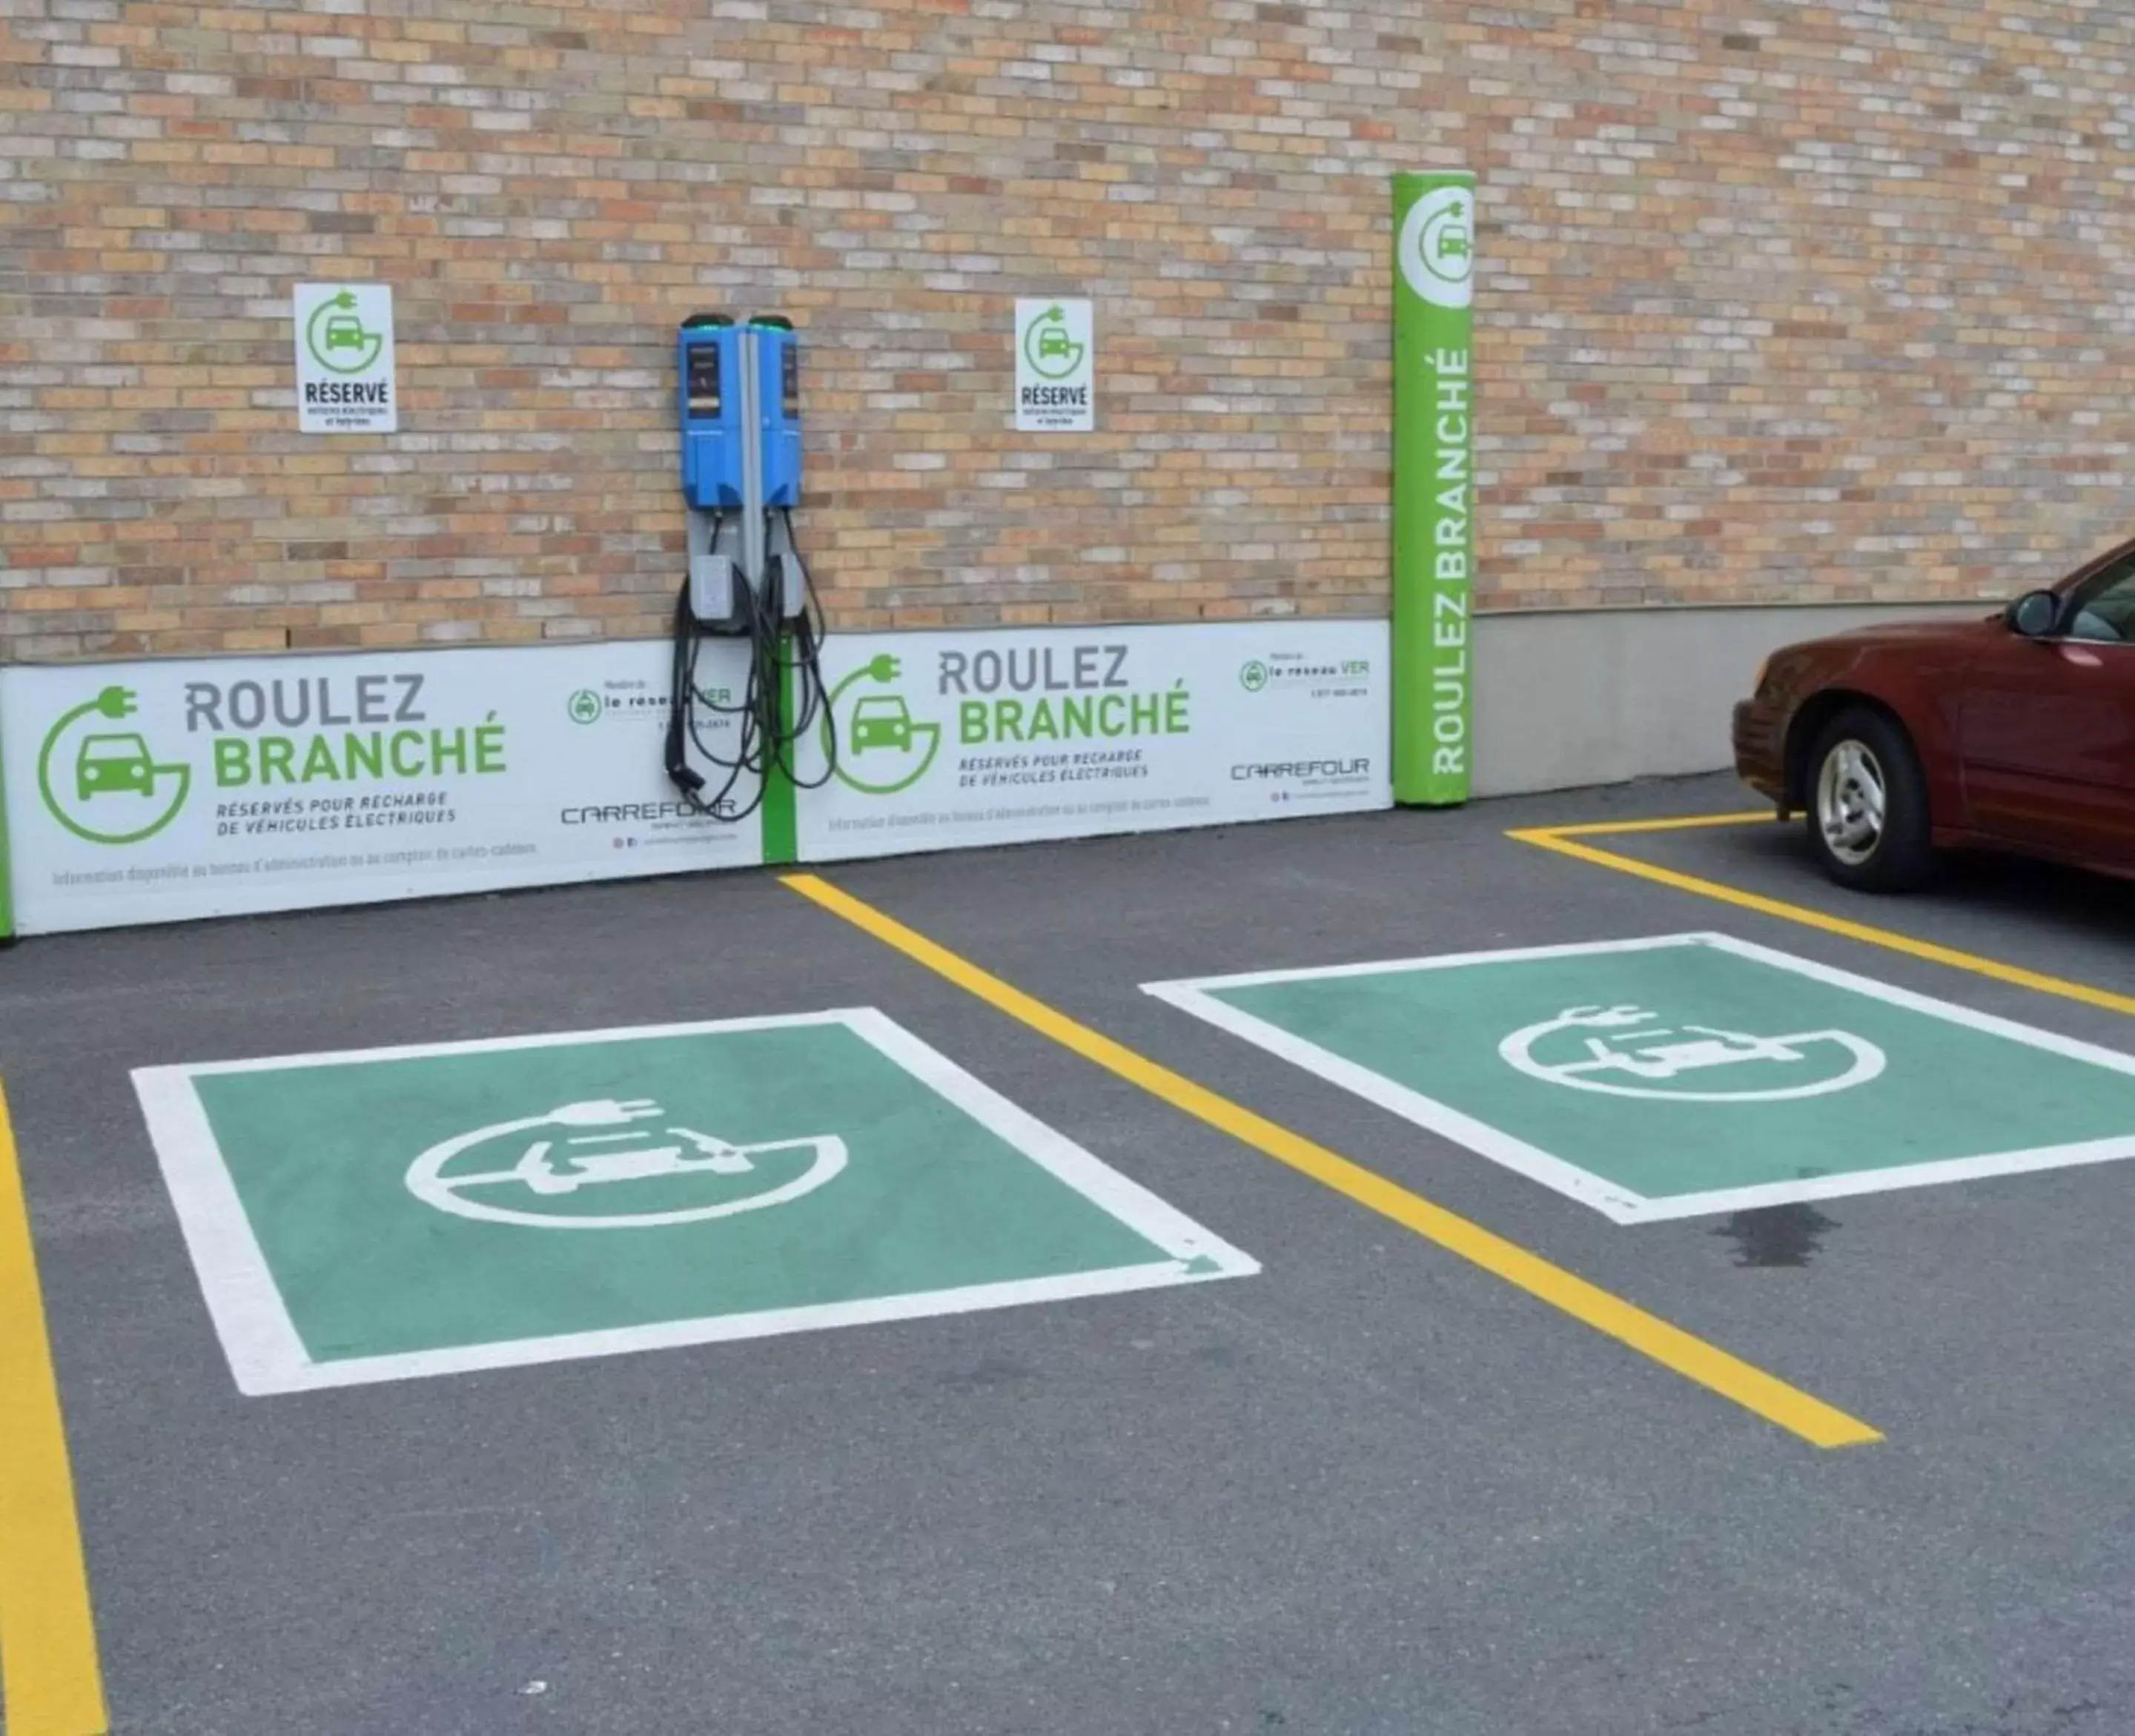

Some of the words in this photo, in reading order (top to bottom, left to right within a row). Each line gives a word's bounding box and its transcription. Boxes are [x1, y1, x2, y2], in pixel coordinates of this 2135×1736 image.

[305, 377, 388, 403] RÉSERVÉ
[1022, 380, 1088, 405] RÉSERVÉ
[1424, 348, 1467, 579] BRANCHÉ
[938, 644, 1129, 695] ROULEZ
[1432, 592, 1466, 775] ROULEZ
[184, 673, 426, 732] ROULEZ
[959, 677, 1190, 744] BRANCHÉ
[214, 709, 507, 787] BRANCHÉ
[1033, 752, 1069, 767] POUR
[959, 773, 976, 788] DE
[1231, 758, 1370, 780] CARREFOUR
[216, 797, 304, 818] RÉSERVÉS
[309, 796, 354, 813] POUR
[359, 791, 448, 810] RECHARGE
[216, 820, 239, 837] DE
[245, 814, 339, 835] VÉHICULES
[344, 807, 456, 829] ÉLECTRIQUES
